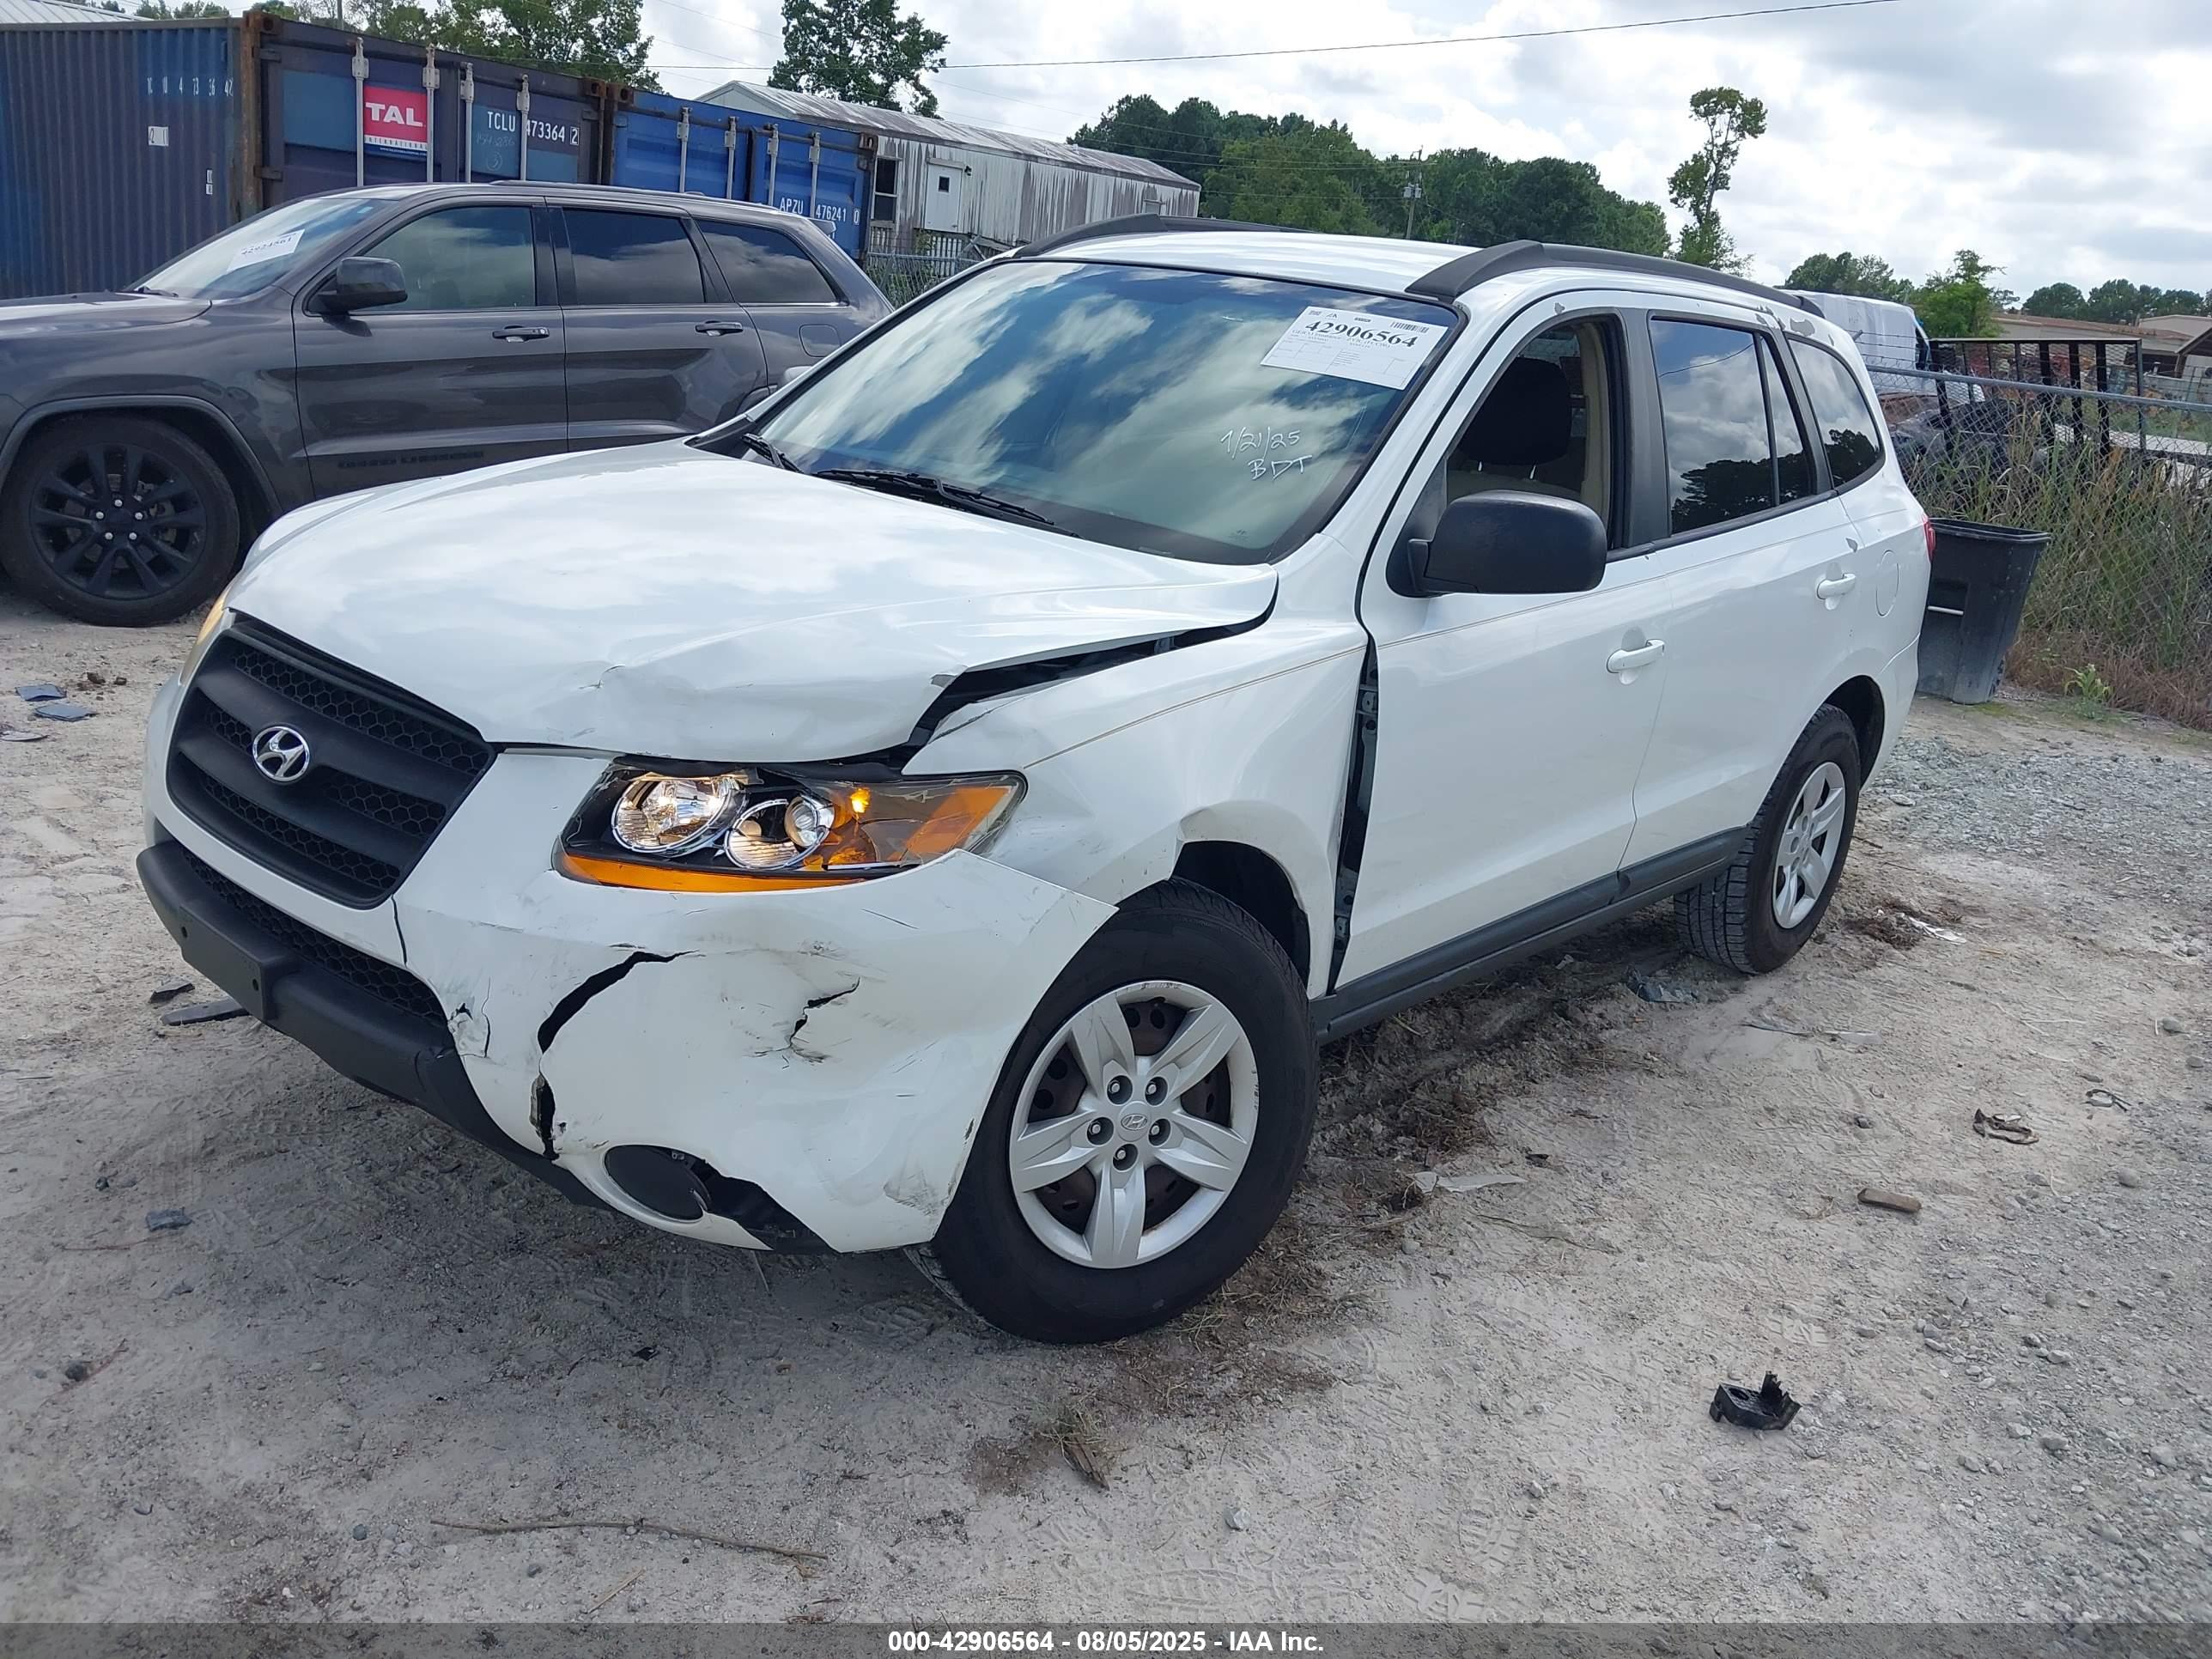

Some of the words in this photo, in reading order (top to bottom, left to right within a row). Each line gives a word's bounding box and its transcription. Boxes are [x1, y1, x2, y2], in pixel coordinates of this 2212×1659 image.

[365, 101, 423, 127] TAL
[487, 111, 516, 132] TCLU
[526, 119, 566, 143] 473364
[570, 126, 580, 145] 2
[779, 197, 804, 215] APZU
[815, 204, 847, 222] 476241
[1304, 319, 1419, 348] 42906564
[1247, 454, 1313, 480] BDT
